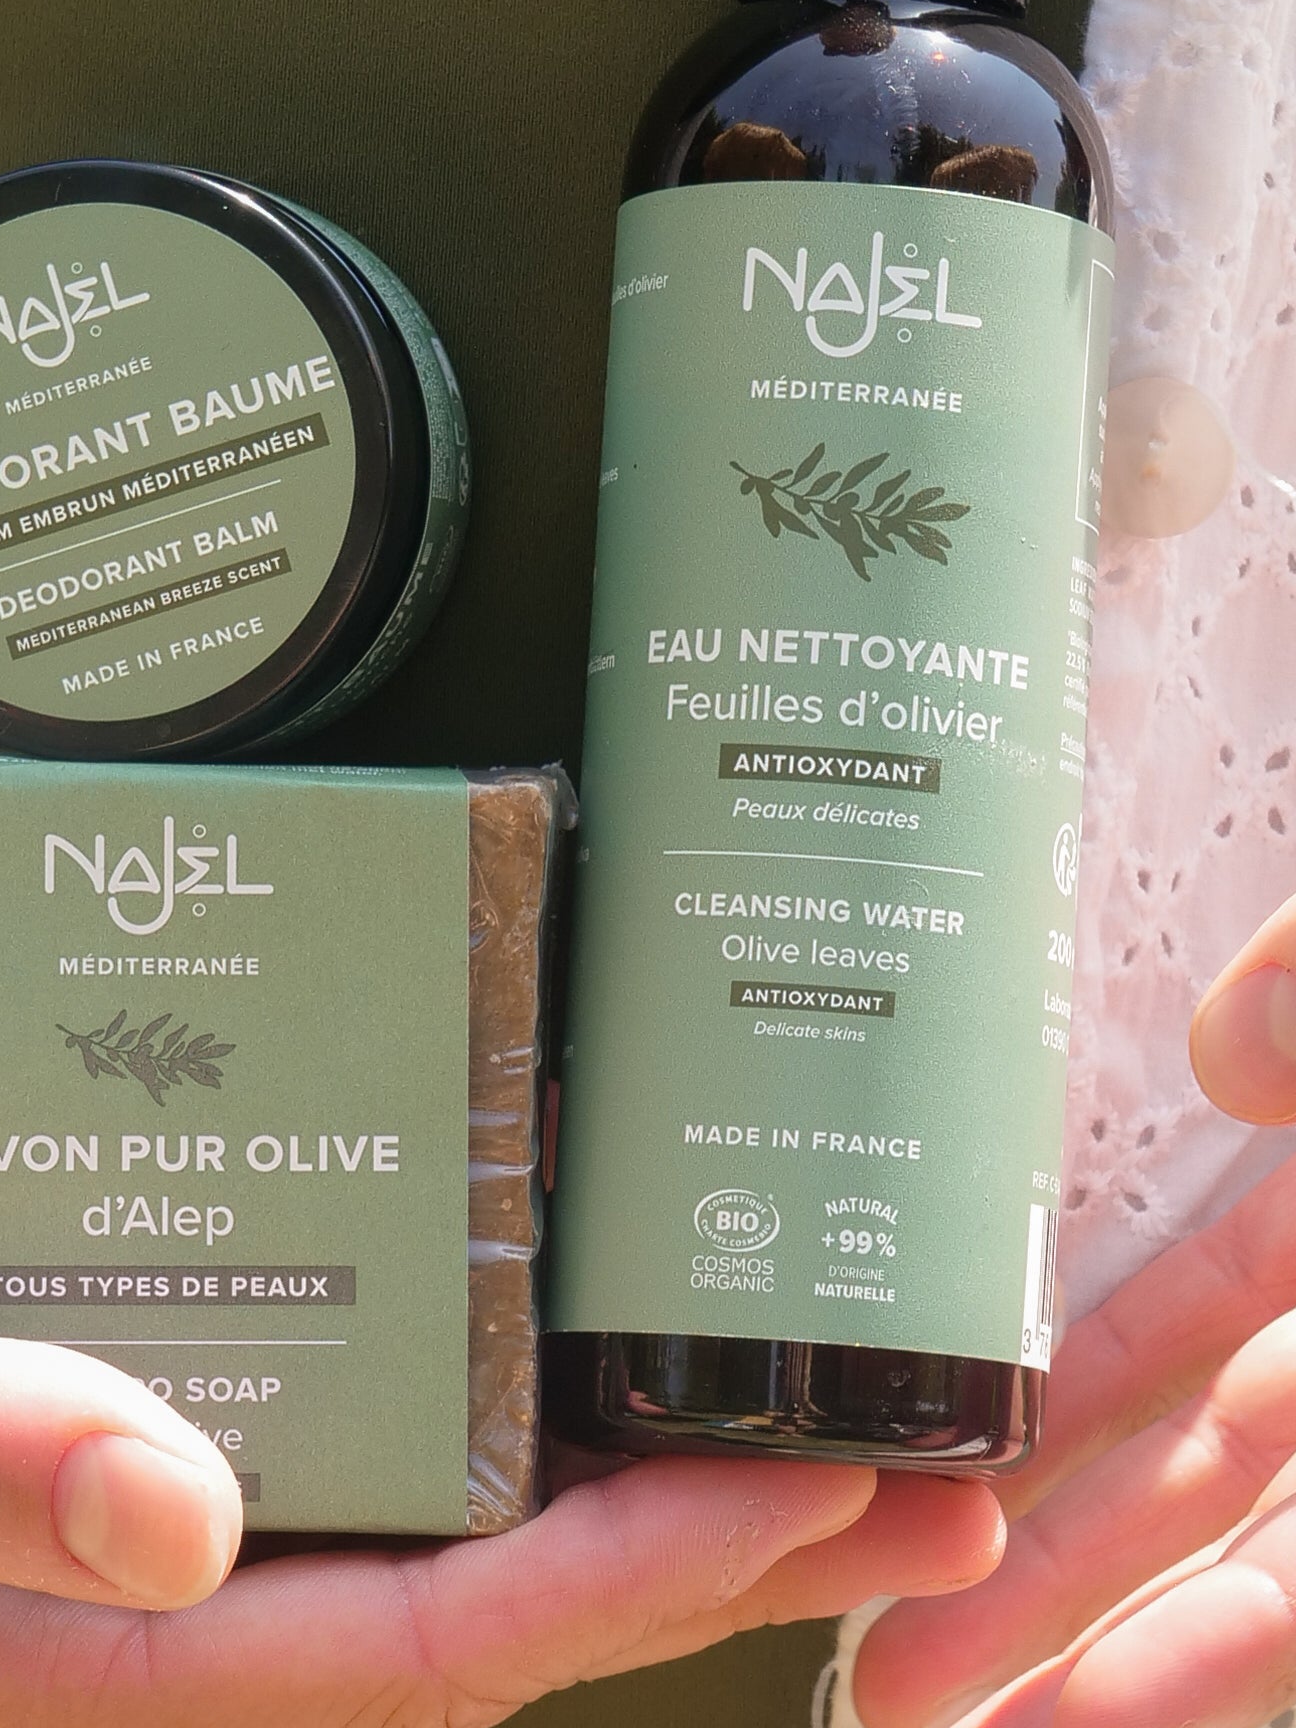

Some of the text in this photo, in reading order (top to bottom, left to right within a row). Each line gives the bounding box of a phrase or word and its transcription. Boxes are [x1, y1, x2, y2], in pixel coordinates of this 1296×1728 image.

[4, 356, 154, 415] MÉDITERRANÉE
[168, 355, 336, 437] BAUME
[750, 376, 964, 414] MÉDITERRANÉE
[20, 491, 116, 537] EMBRUN
[122, 424, 316, 500] MÉDITERRANÉEN
[193, 511, 280, 557] BALM
[16, 556, 283, 652] MEDITERRANEAN BREEZE SCENT
[62, 617, 265, 695] MADE IN FRANCE
[647, 628, 722, 665] EAU
[739, 629, 1030, 690] NETTOYANTE
[666, 684, 1004, 742] Feuilles d'olivier
[733, 753, 926, 785] ANTIOXYDANT
[732, 797, 920, 830] Peaux délicates
[674, 892, 965, 936] CLEANSING WATER
[58, 952, 261, 977] MÉDITERRANÉE
[721, 934, 910, 973] Olive leaves
[741, 988, 884, 1012] ANTIOXYDANT
[753, 1021, 866, 1043] Delicate skins
[120, 1135, 226, 1172] PUR
[246, 1135, 401, 1173] OLIVE
[683, 1124, 922, 1161] MADE IN FRANCE
[81, 1194, 235, 1246] d'Alep
[716, 1210, 760, 1232] BIO
[824, 1197, 899, 1225] NATURAL
[690, 1273, 774, 1293] ORGANIC
[692, 1255, 774, 1275] COSMOS
[828, 1264, 885, 1282] D'ORIGINE
[77, 1276, 172, 1298] TYPES
[180, 1276, 221, 1298] DE
[230, 1276, 329, 1298] PEAUX
[814, 1282, 896, 1303] NATURELLE
[186, 1377, 281, 1402] SOAP
